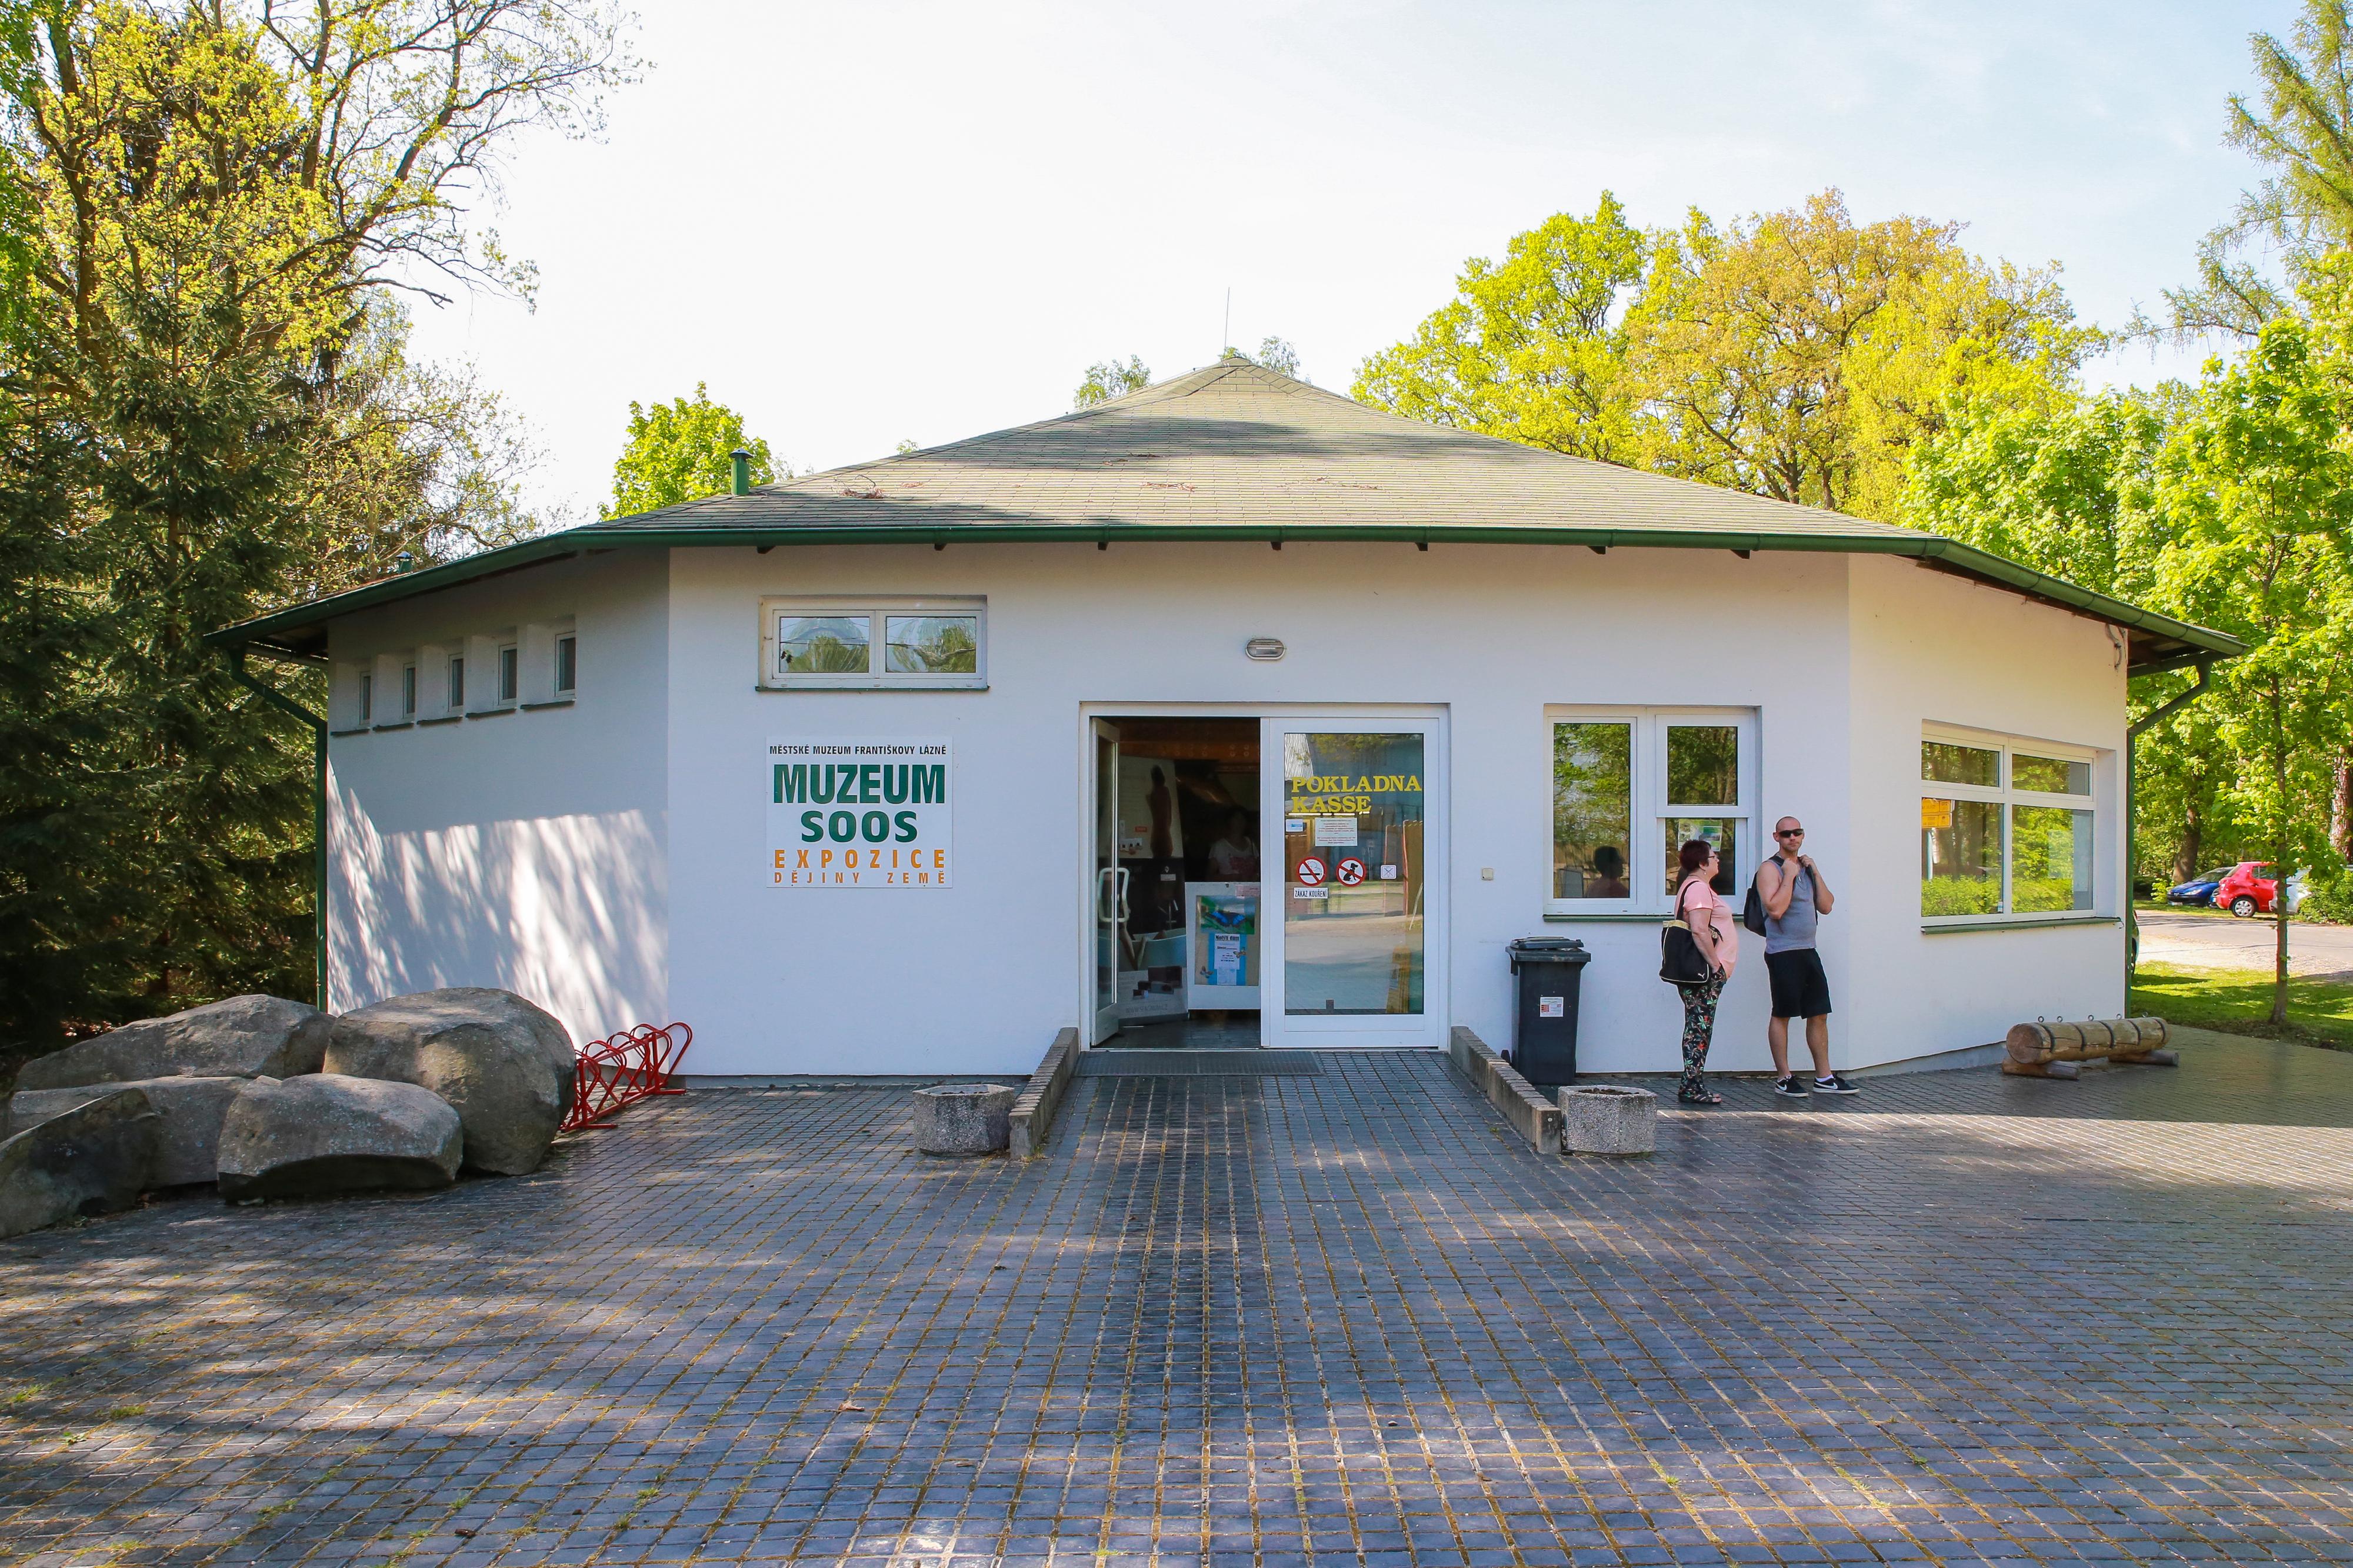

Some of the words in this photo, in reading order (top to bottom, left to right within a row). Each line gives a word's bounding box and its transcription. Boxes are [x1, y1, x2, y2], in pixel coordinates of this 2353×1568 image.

[770, 745, 809, 755] MĚSTSKÉ
[813, 746, 851, 755] MUZEUM
[855, 745, 915, 755] FRANTIŠKOVY
[919, 745, 946, 755] LÁZNĚ
[774, 765, 945, 804] MUZEUM
[1291, 775, 1422, 793] POKLADNA
[1291, 796, 1372, 813] KASSE
[801, 810, 918, 842] SOOS
[775, 849, 945, 868] EXPOZICE
[775, 870, 859, 883] DĚJINY
[887, 870, 945, 883] ZEMĚ
